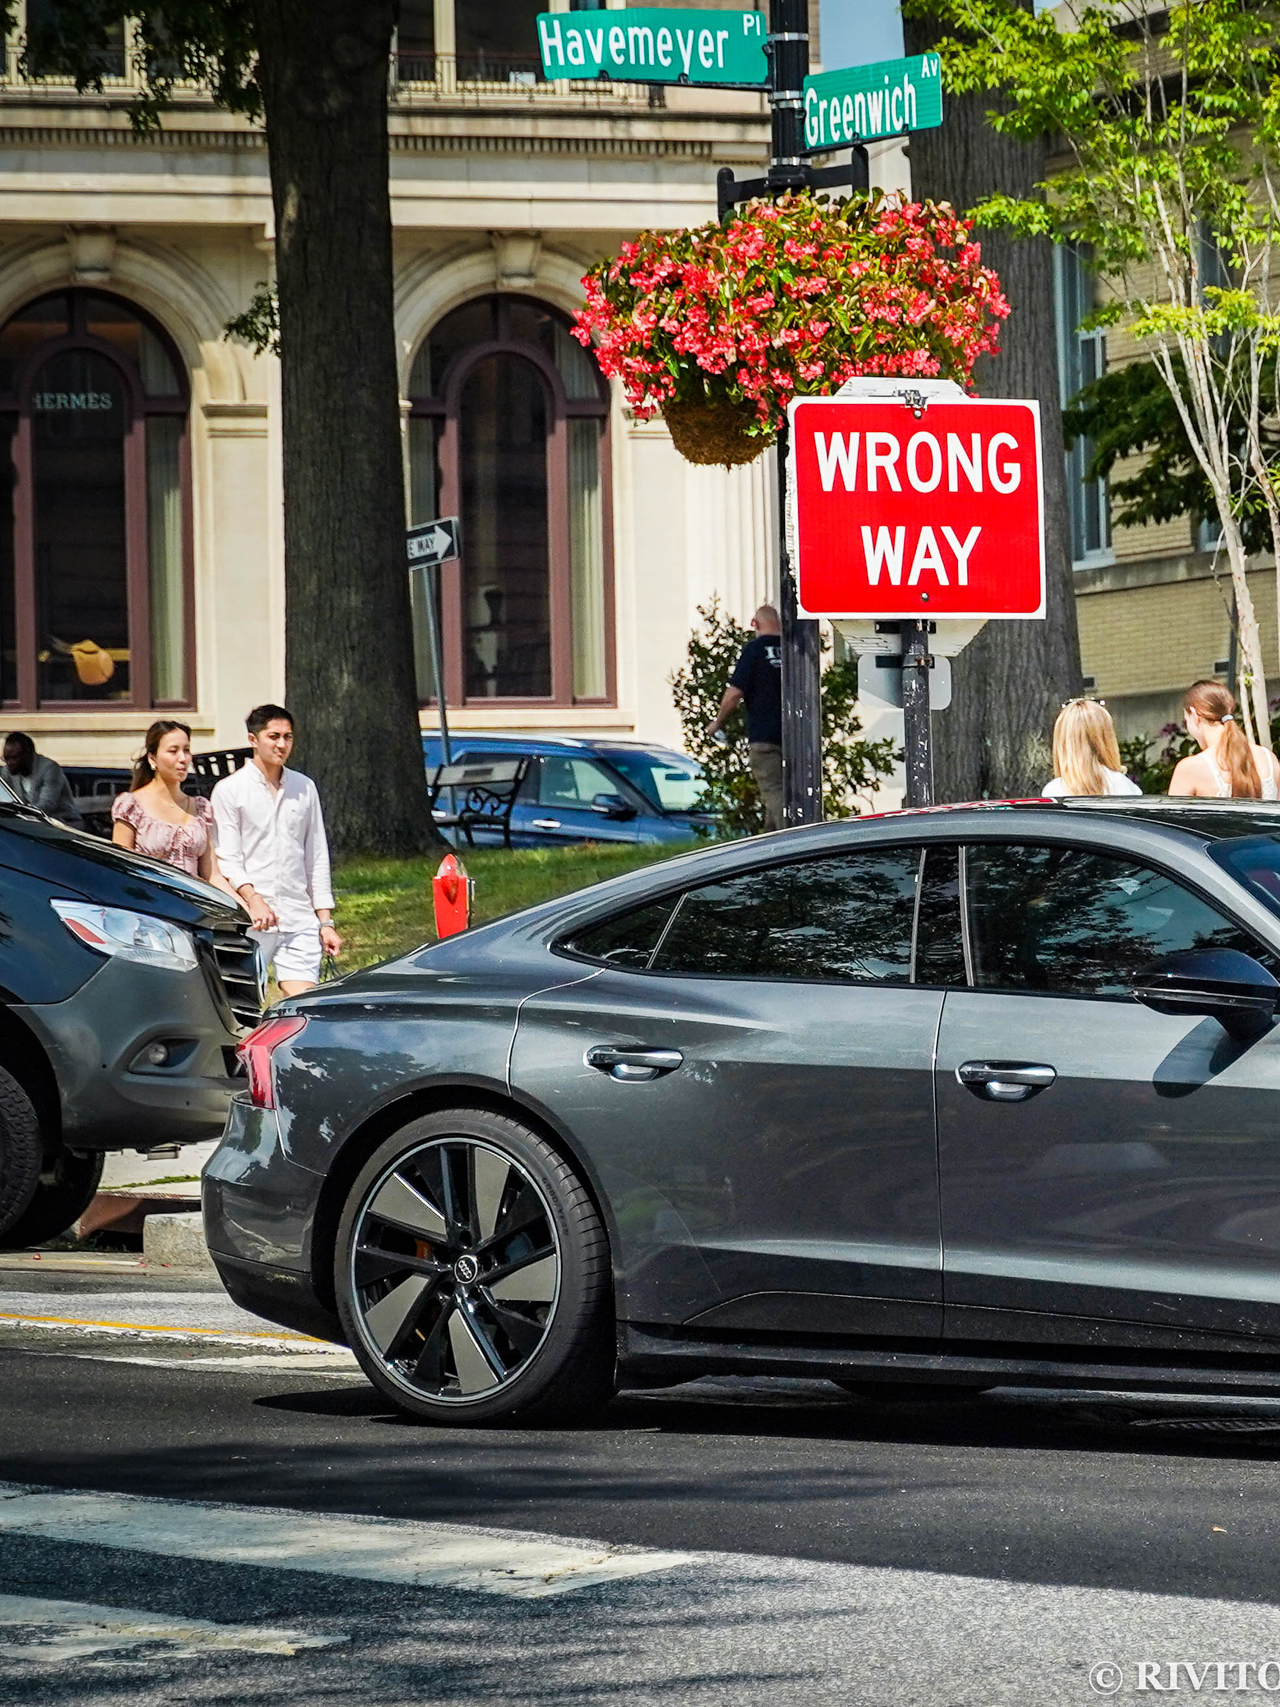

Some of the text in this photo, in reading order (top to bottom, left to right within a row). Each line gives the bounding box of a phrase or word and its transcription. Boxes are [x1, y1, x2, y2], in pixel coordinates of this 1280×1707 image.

[540, 14, 761, 75] Havemeyer Pl
[805, 55, 938, 147] Greenwich Av
[814, 431, 1021, 494] WRONG
[417, 536, 435, 553] WAY
[861, 525, 982, 586] WAY
